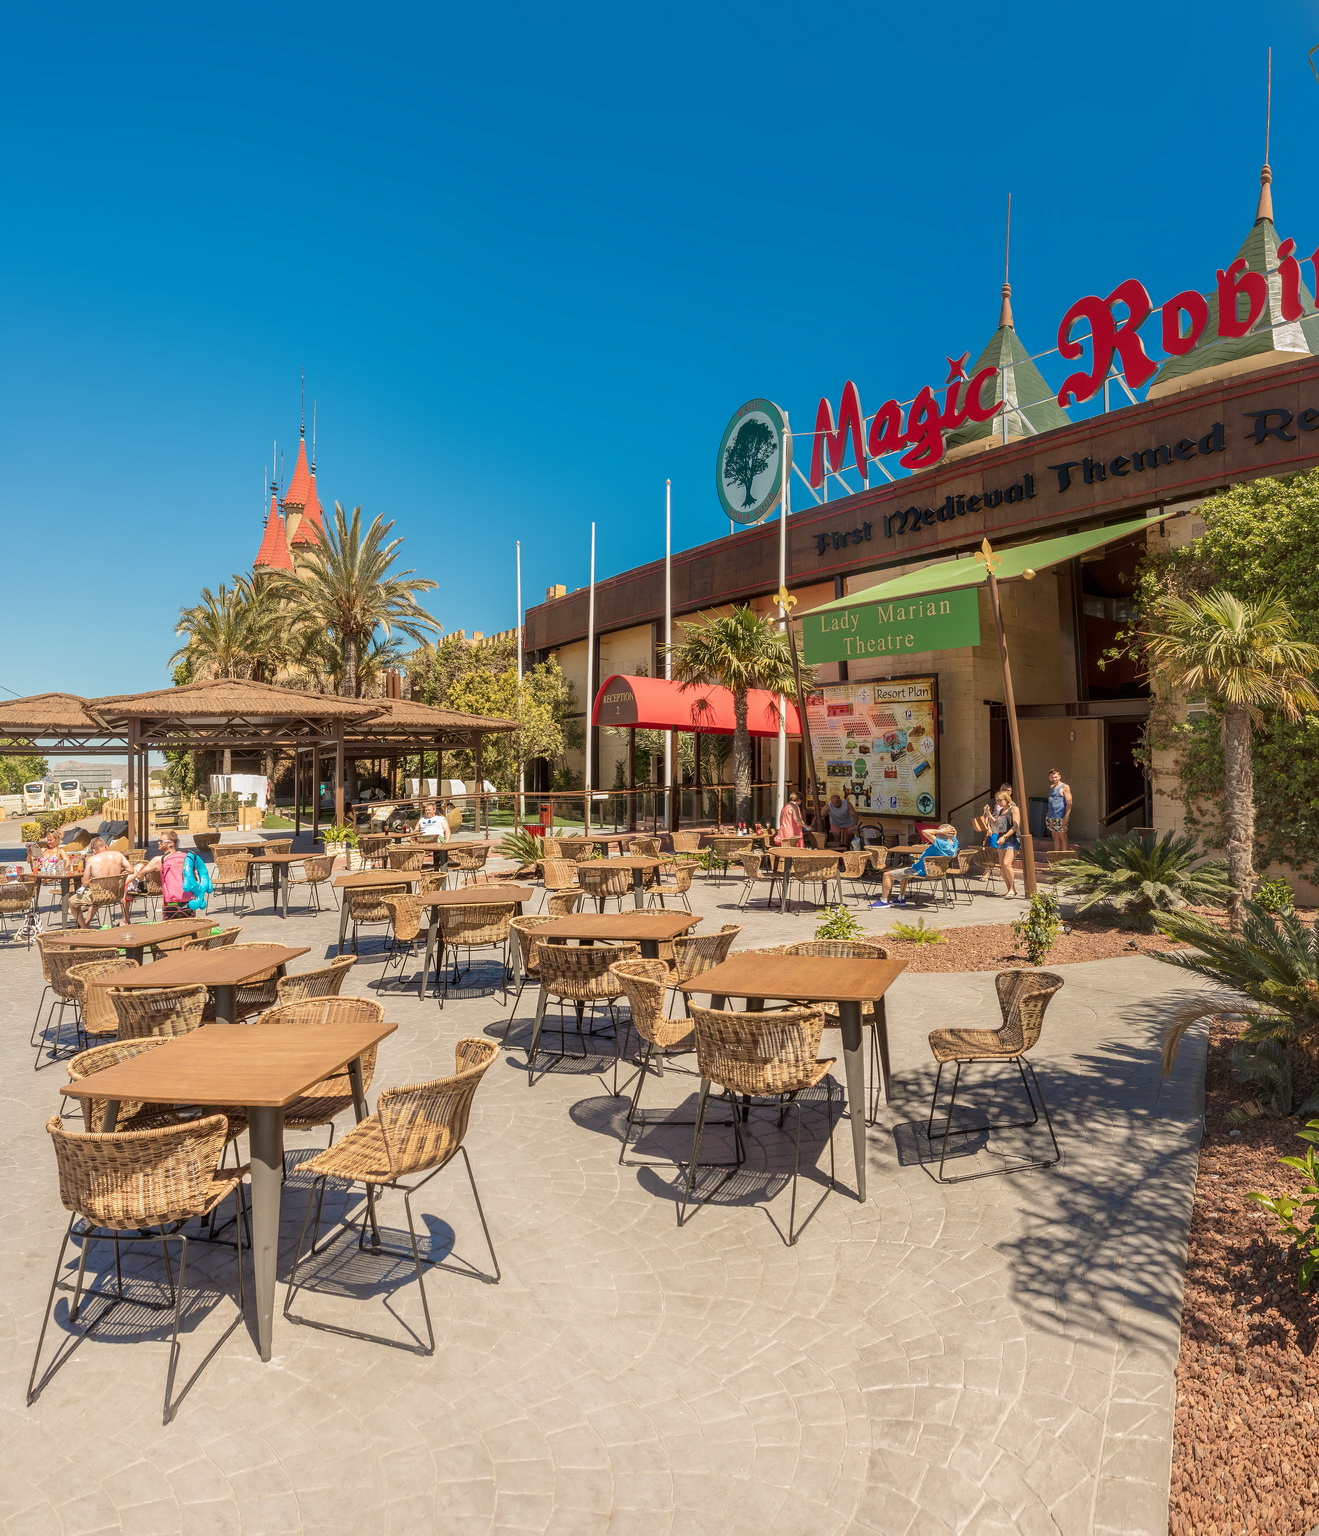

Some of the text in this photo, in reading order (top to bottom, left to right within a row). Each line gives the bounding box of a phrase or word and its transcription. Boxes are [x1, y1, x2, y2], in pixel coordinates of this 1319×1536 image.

[737, 401, 763, 418] MAGIC
[810, 350, 1007, 489] Magic
[812, 521, 873, 556] First
[883, 473, 1037, 538] Medieval
[1047, 421, 1227, 493] Themed
[728, 492, 775, 522] ROBIN HOOD
[820, 599, 951, 633] Lady Marian
[843, 633, 915, 655] Theatre
[603, 692, 634, 703] RECEPTION
[877, 686, 929, 699] Resort Plan
[616, 705, 620, 715] 2
